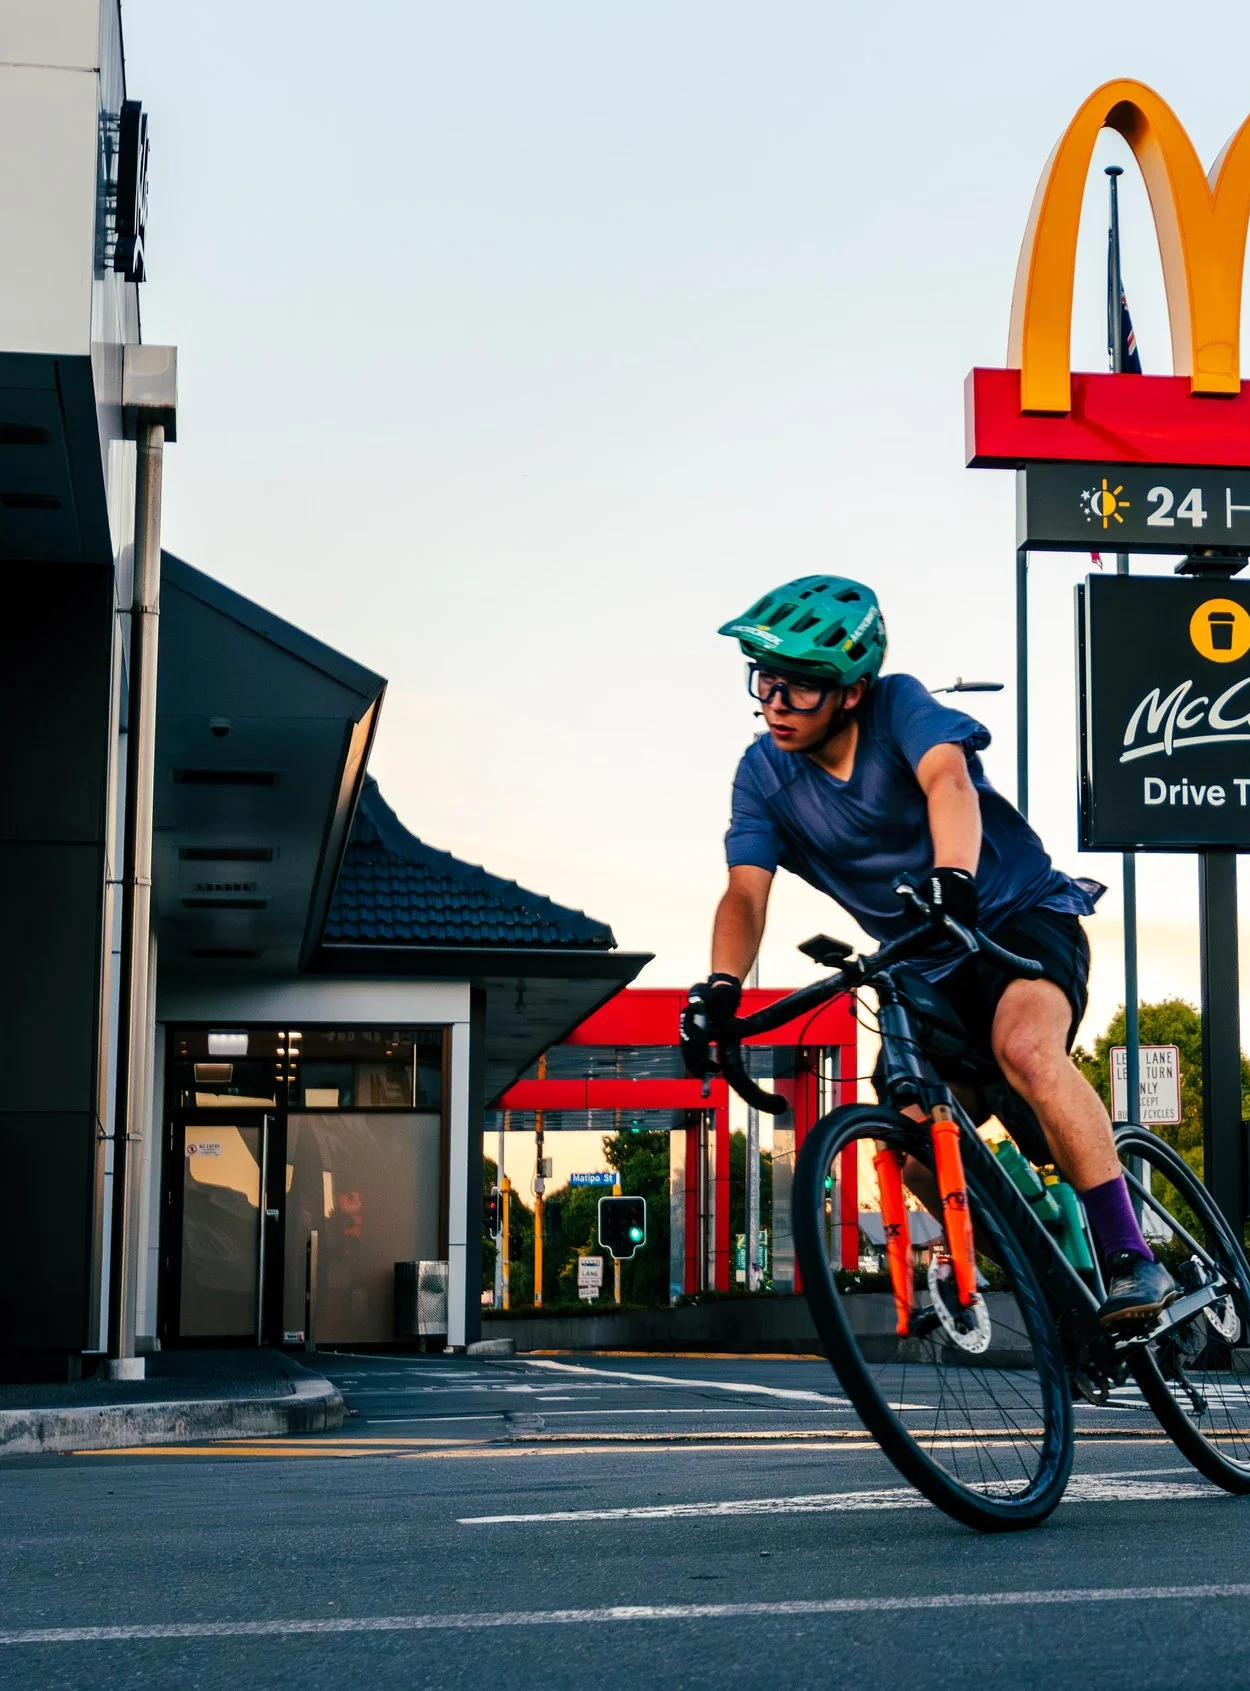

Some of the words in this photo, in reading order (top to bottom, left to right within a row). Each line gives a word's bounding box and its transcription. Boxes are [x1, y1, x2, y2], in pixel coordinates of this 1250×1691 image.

[1146, 486, 1208, 528] 24
[1143, 777, 1226, 805] Drive
[1145, 1051, 1173, 1065] LANE
[1146, 1066, 1174, 1079] TURN
[1140, 1082, 1158, 1094] NLY
[1140, 1096, 1159, 1107] CEPT
[572, 1173, 600, 1184] Matipo
[603, 1173, 613, 1182] St
